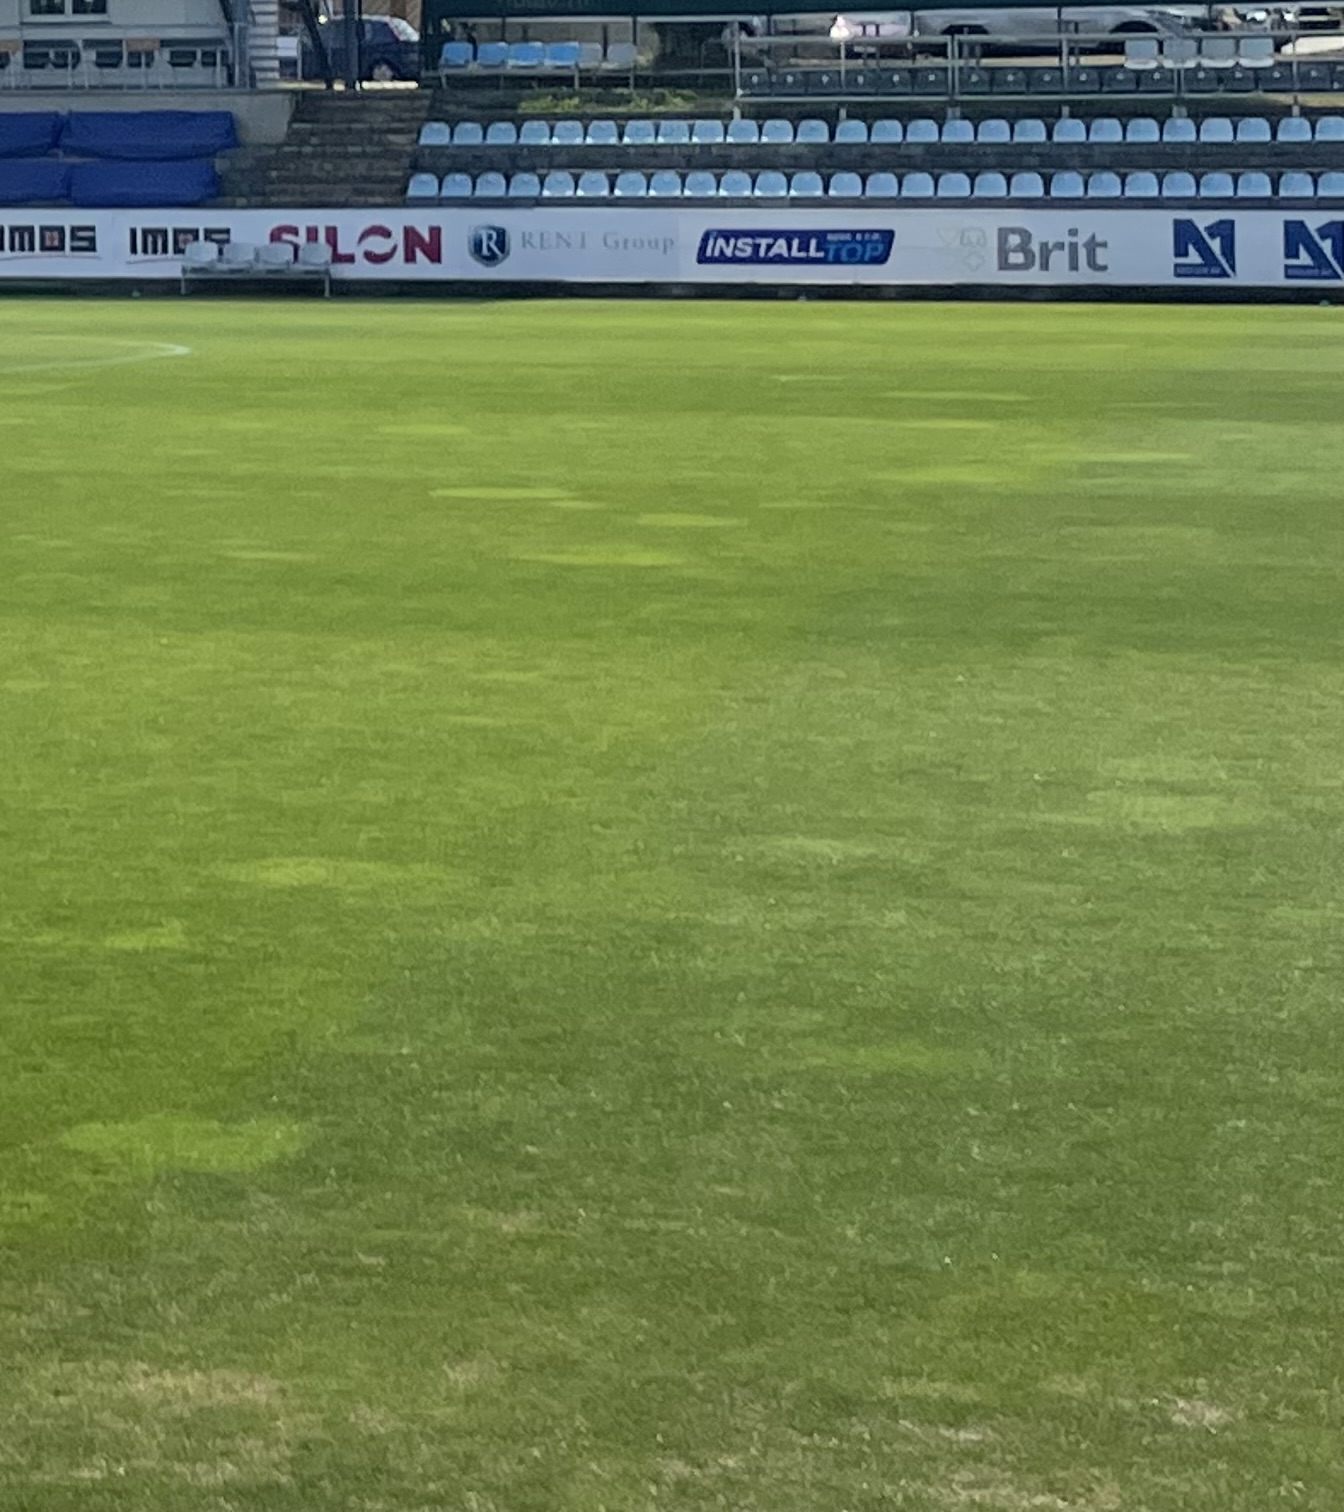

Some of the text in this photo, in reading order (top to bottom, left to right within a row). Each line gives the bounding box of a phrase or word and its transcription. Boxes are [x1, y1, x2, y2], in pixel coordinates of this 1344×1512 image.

[521, 231, 589, 250] RENT
[603, 231, 675, 255] Group
[705, 232, 885, 262] INSTALL TOP
[997, 226, 1109, 273] Brit
